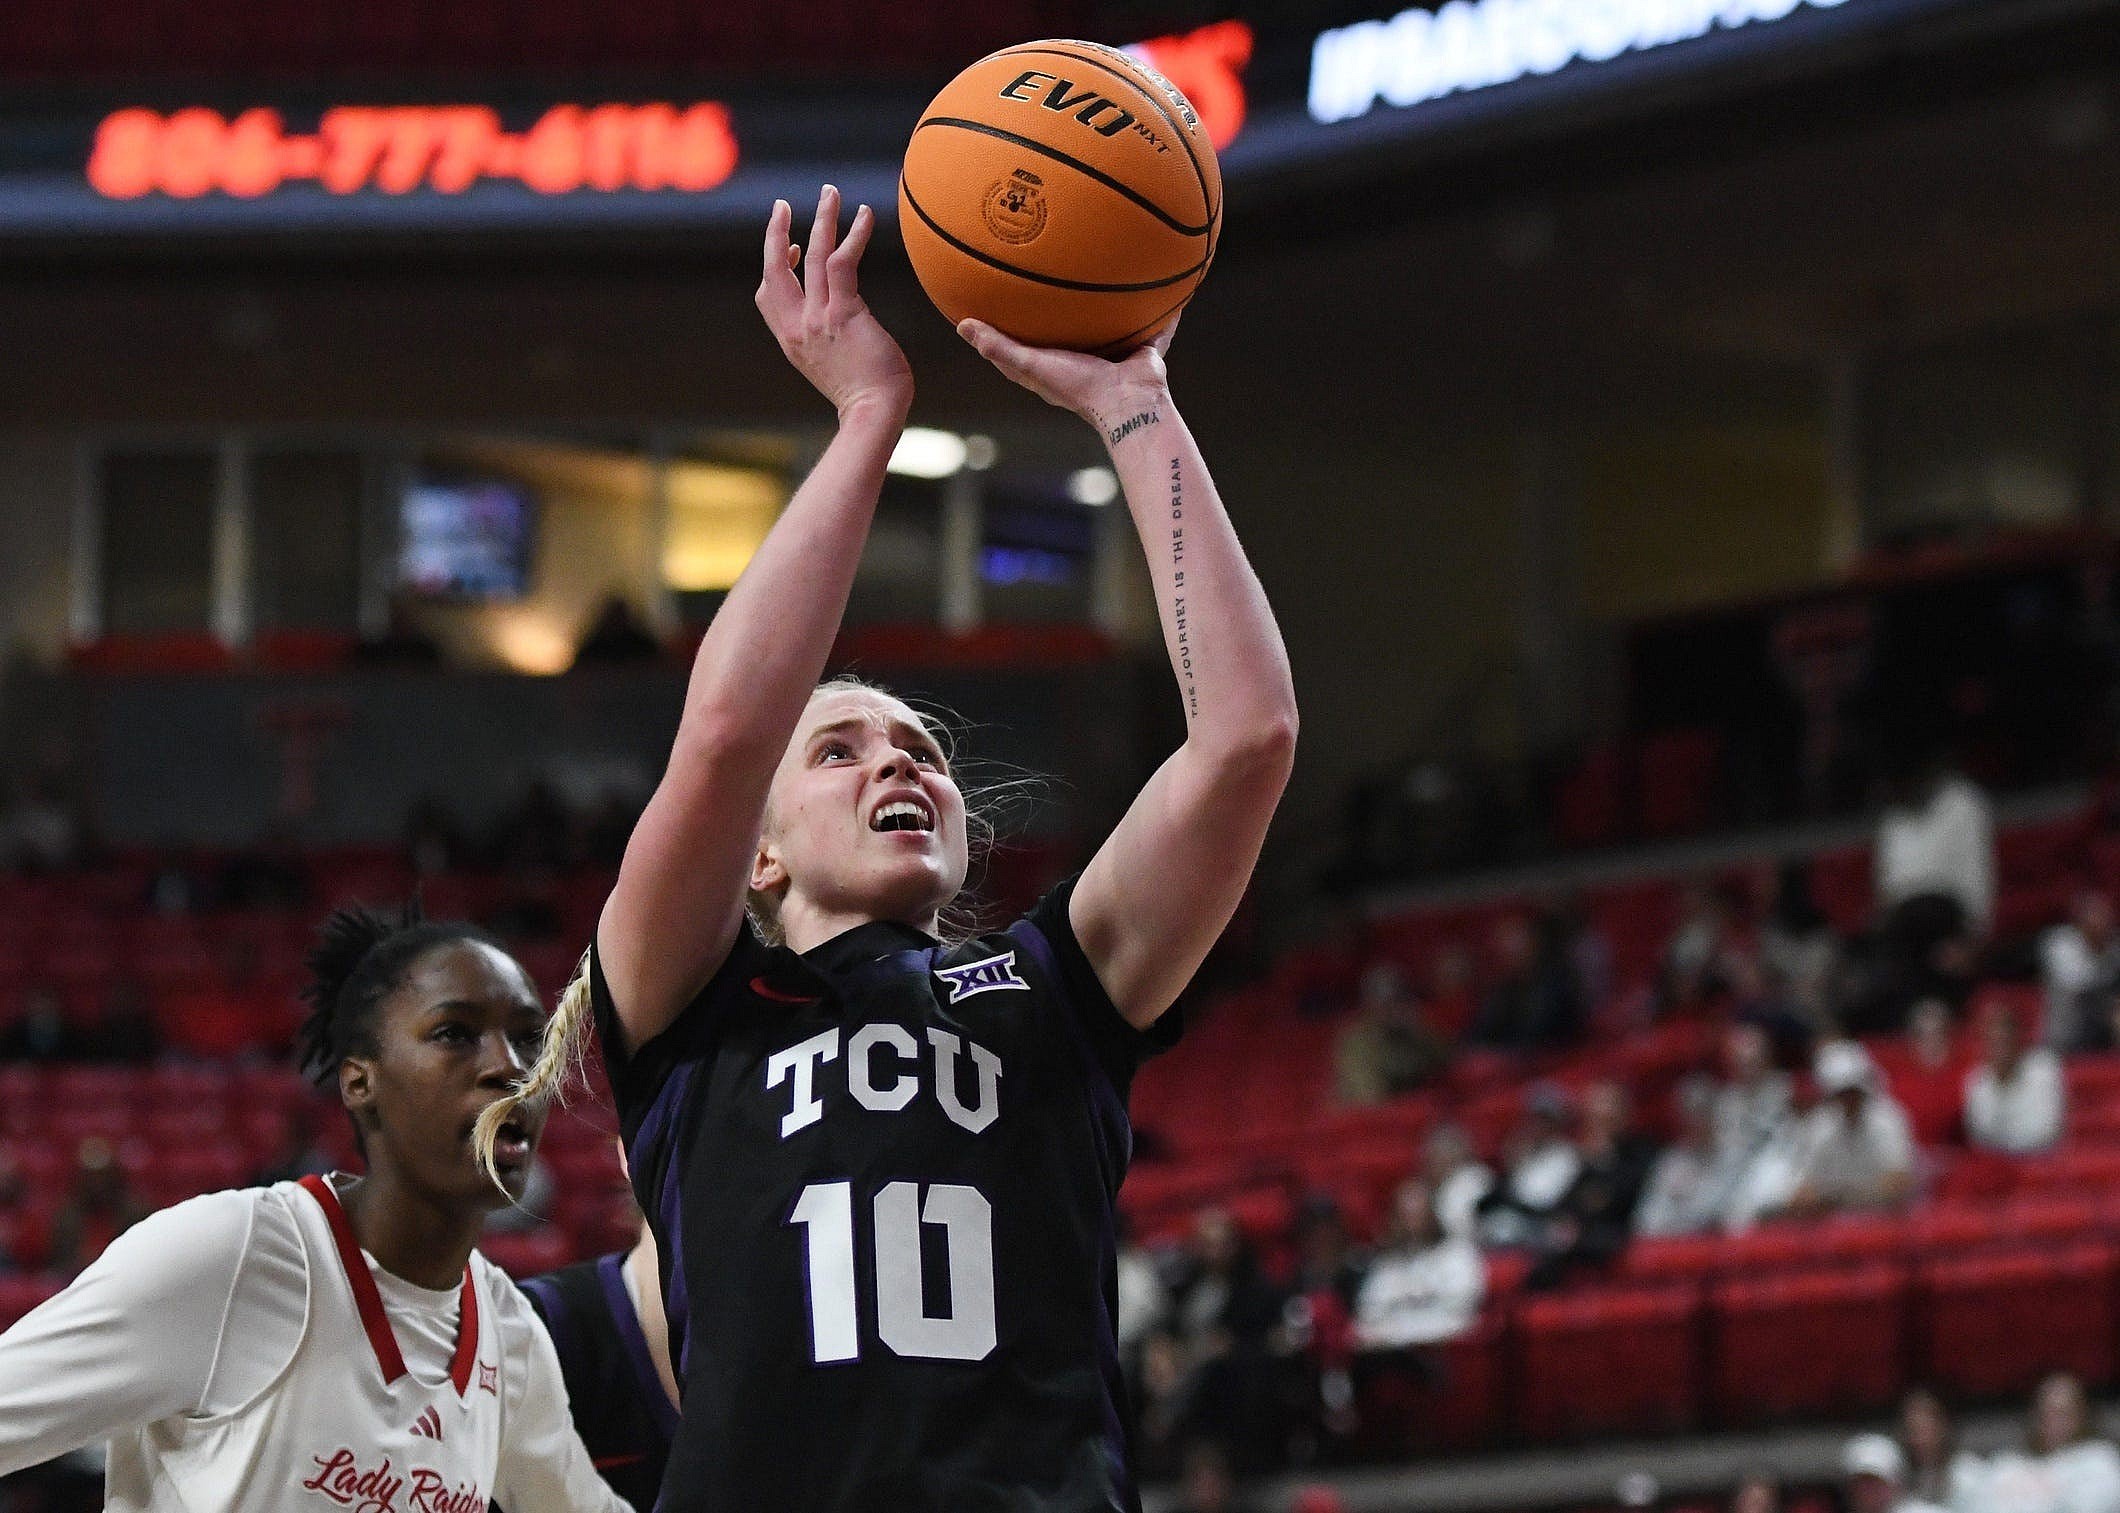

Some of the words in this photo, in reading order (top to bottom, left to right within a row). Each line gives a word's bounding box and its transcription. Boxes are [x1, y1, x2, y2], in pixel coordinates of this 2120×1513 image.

[1000, 70, 1135, 138] EVO
[1135, 123, 1169, 155] NXT
[1171, 457, 1182, 520] DREAM
[1173, 527, 1184, 564] THE
[1176, 572, 1185, 588] IS
[1176, 599, 1193, 679] JOURNEY
[1189, 686, 1198, 719] THE
[766, 1023, 1003, 1138] TCU
[789, 1180, 998, 1363] 10
[303, 1449, 403, 1513] Lady
